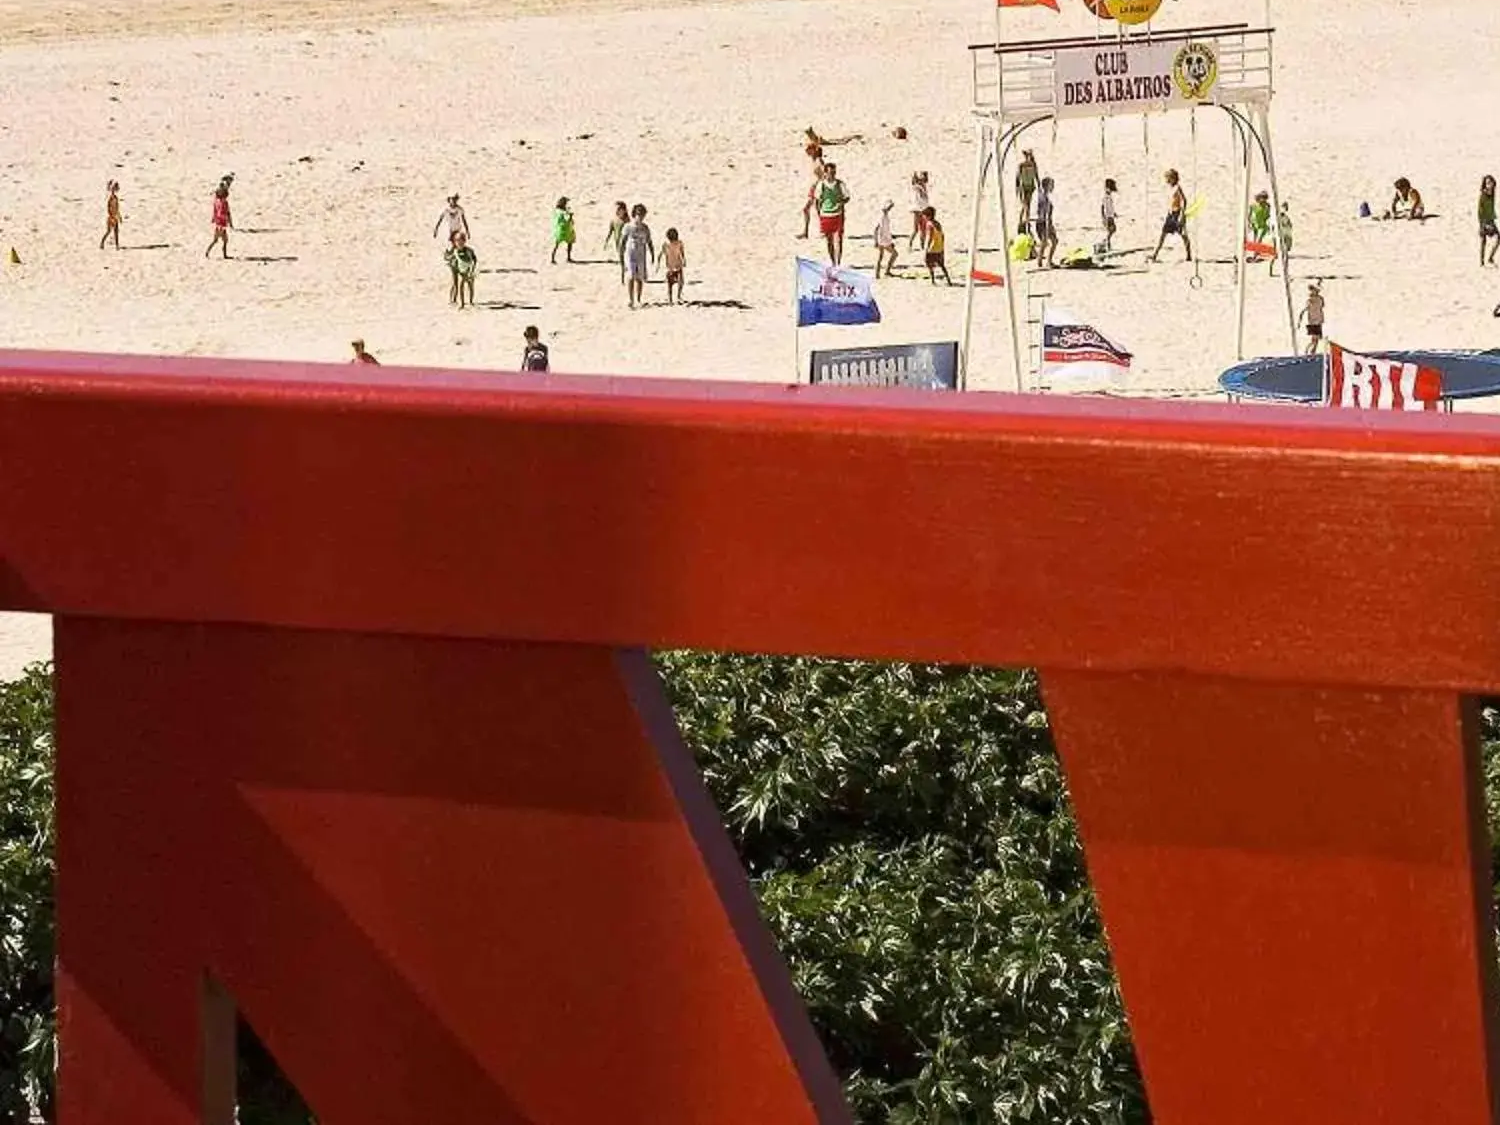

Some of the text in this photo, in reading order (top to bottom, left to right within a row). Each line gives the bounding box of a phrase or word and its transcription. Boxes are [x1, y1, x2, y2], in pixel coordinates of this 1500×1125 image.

[1095, 51, 1129, 76] CLUB
[1064, 75, 1171, 106] DES ALBATROS
[1341, 351, 1424, 412] RTL
